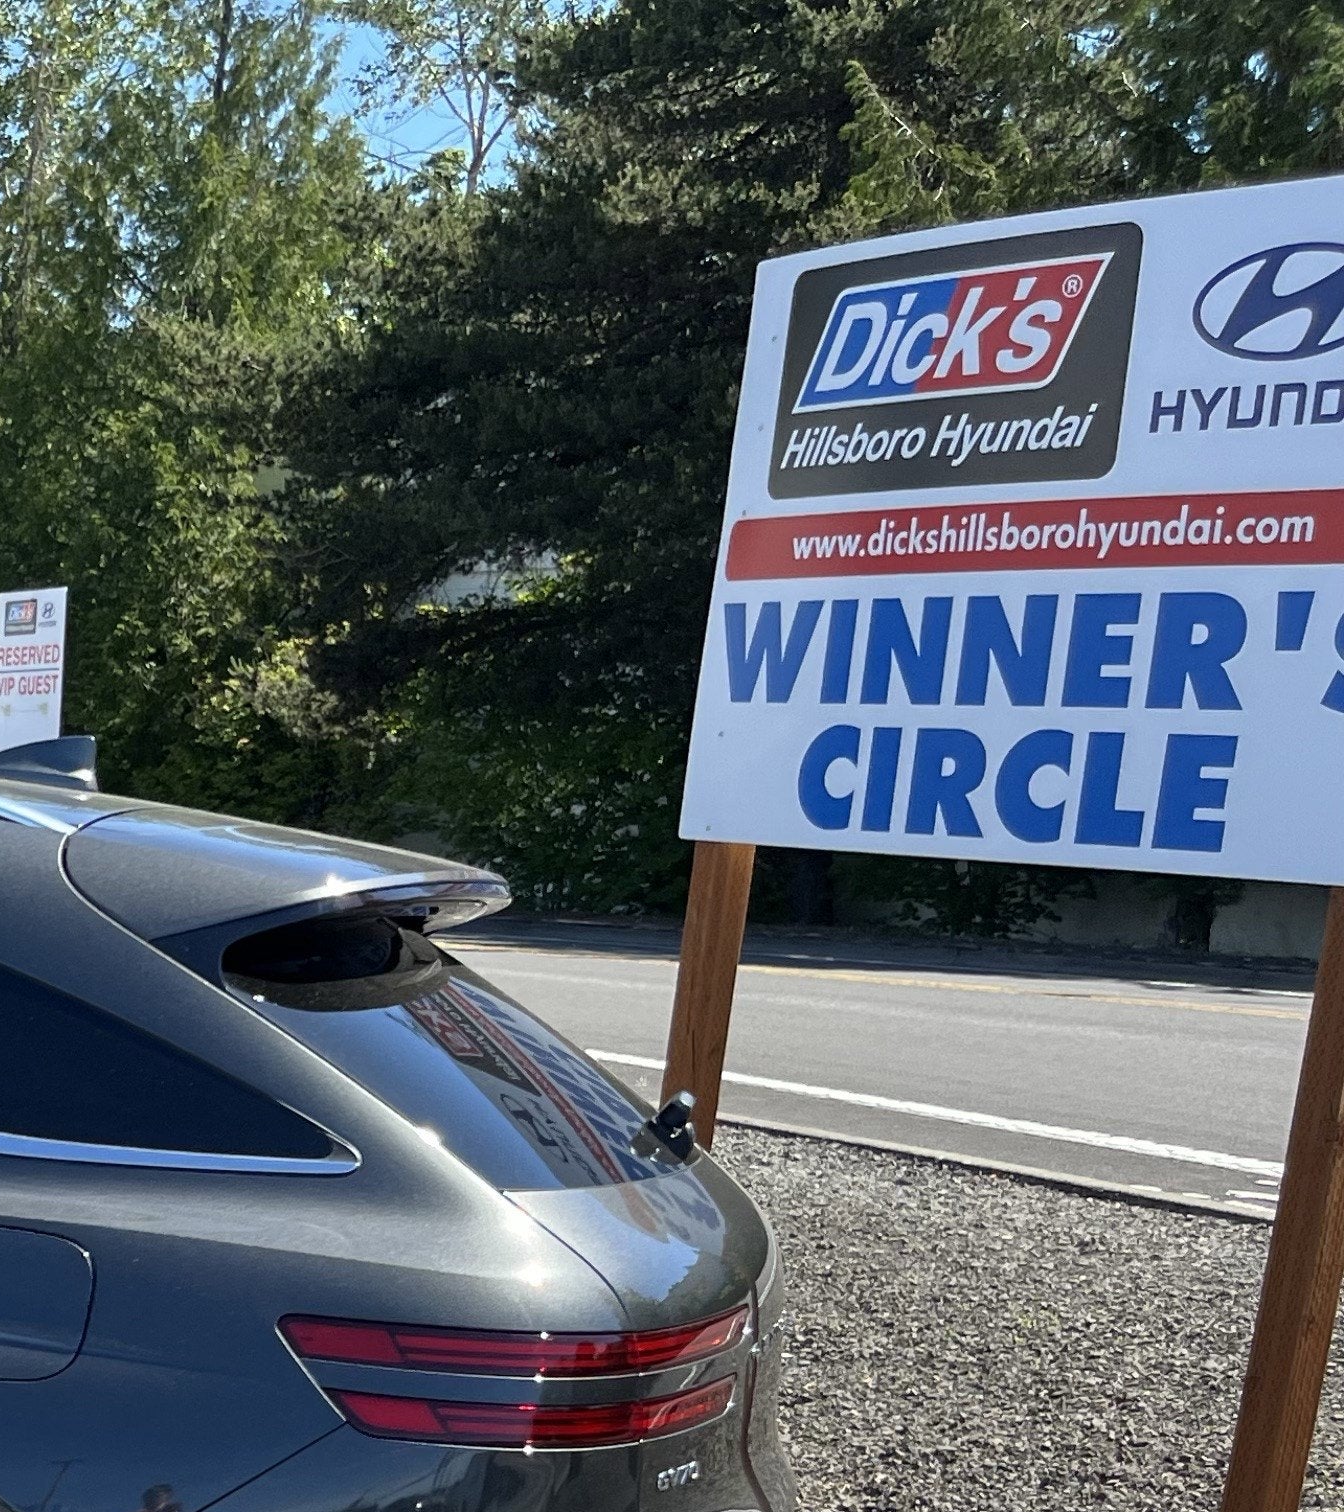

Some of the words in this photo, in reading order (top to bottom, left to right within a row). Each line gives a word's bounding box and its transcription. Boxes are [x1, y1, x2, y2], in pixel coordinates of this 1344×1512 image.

[780, 422, 926, 470] Hillsboro
[930, 403, 1099, 467] Hyundai
[792, 504, 1315, 561] www.dickshillsborohyundai.com
[18, 674, 59, 695] GUEST
[723, 590, 1344, 714] WINNER'
[798, 724, 1239, 853] CIRCLE
